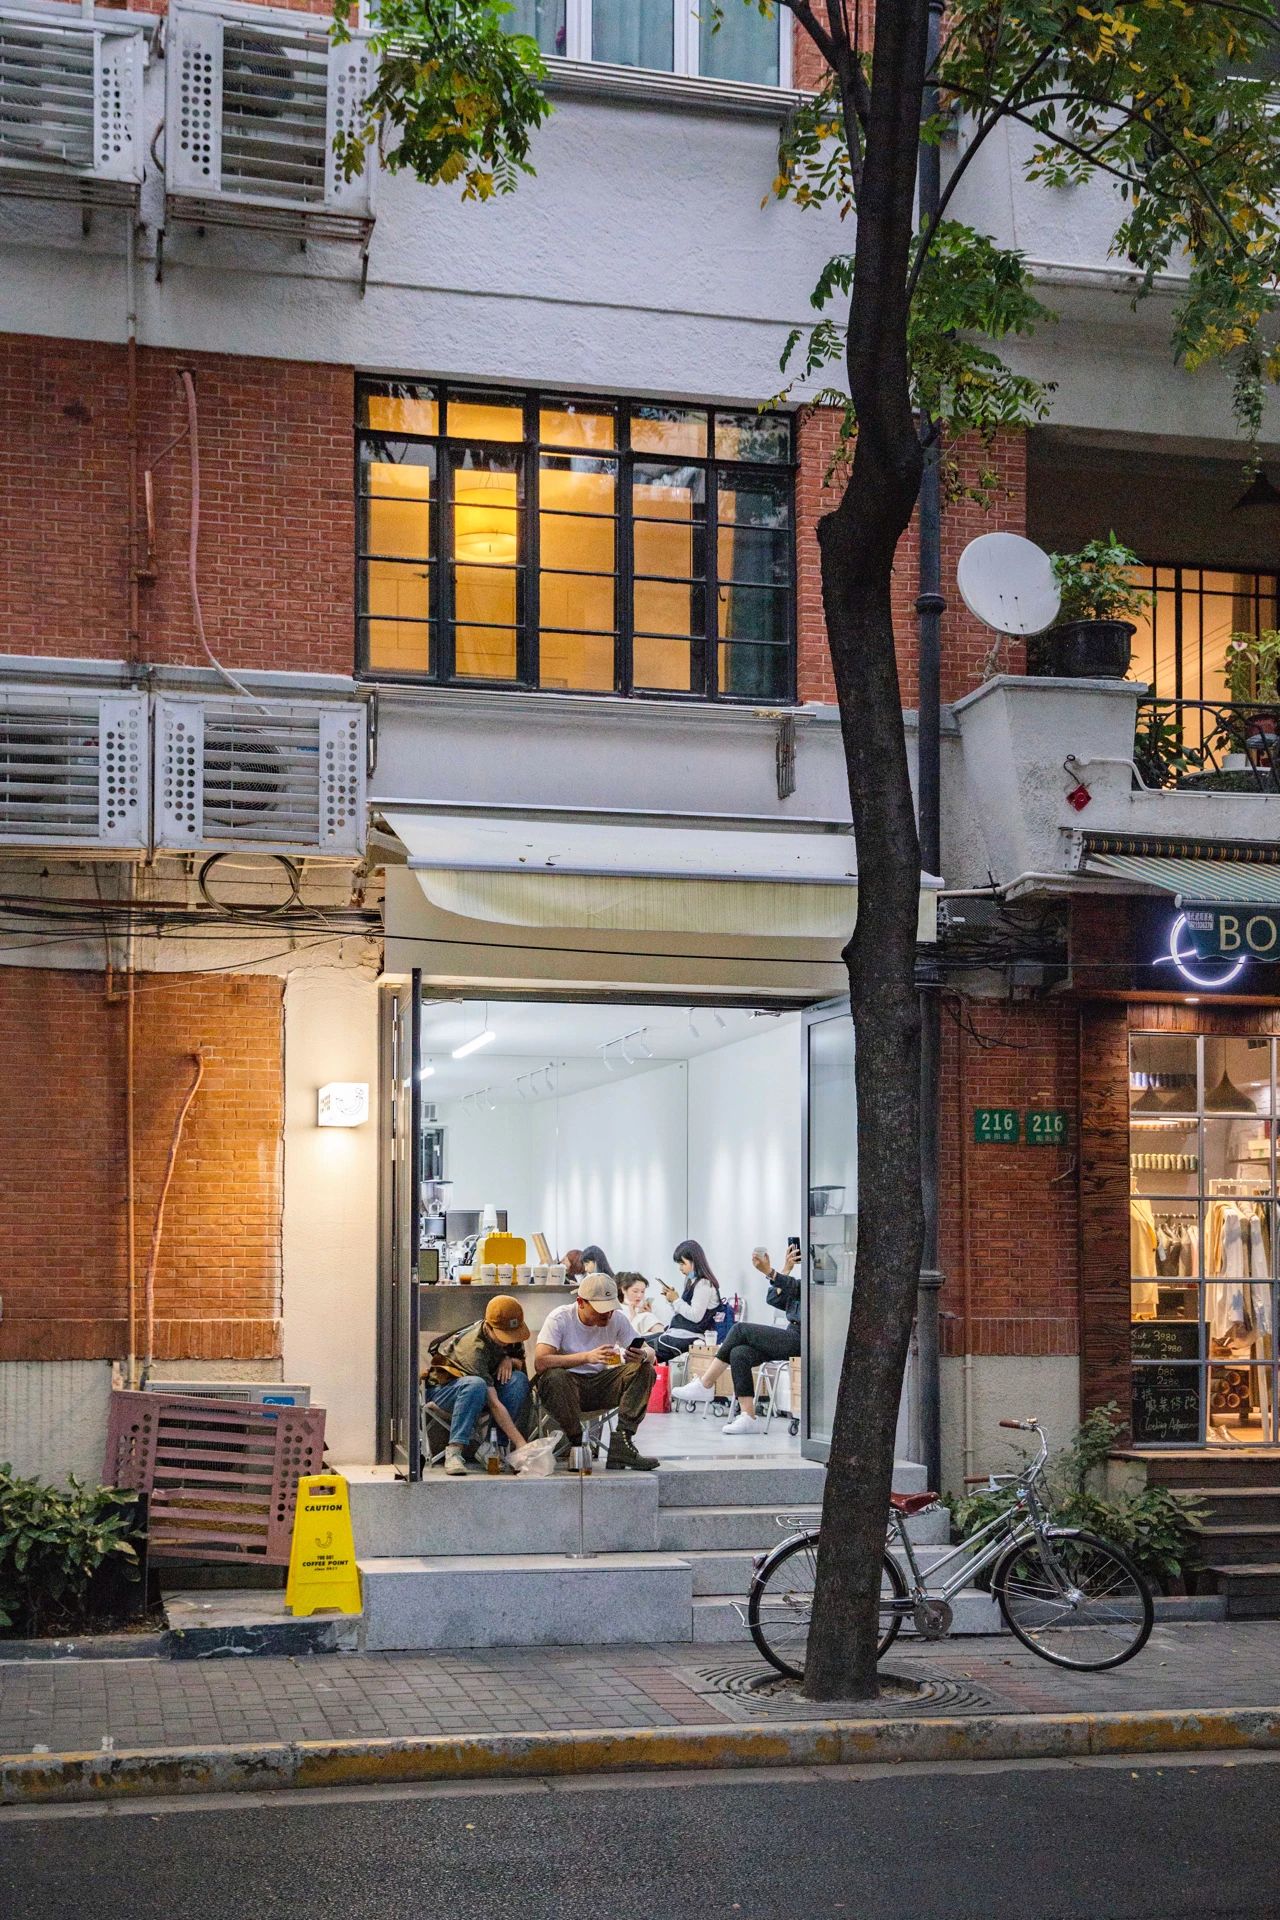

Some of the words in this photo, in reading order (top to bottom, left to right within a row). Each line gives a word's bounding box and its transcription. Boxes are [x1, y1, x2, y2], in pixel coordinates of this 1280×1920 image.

[1219, 915, 1277, 951] BO
[981, 1113, 1013, 1131] 216
[1032, 1115, 1063, 1132] 216
